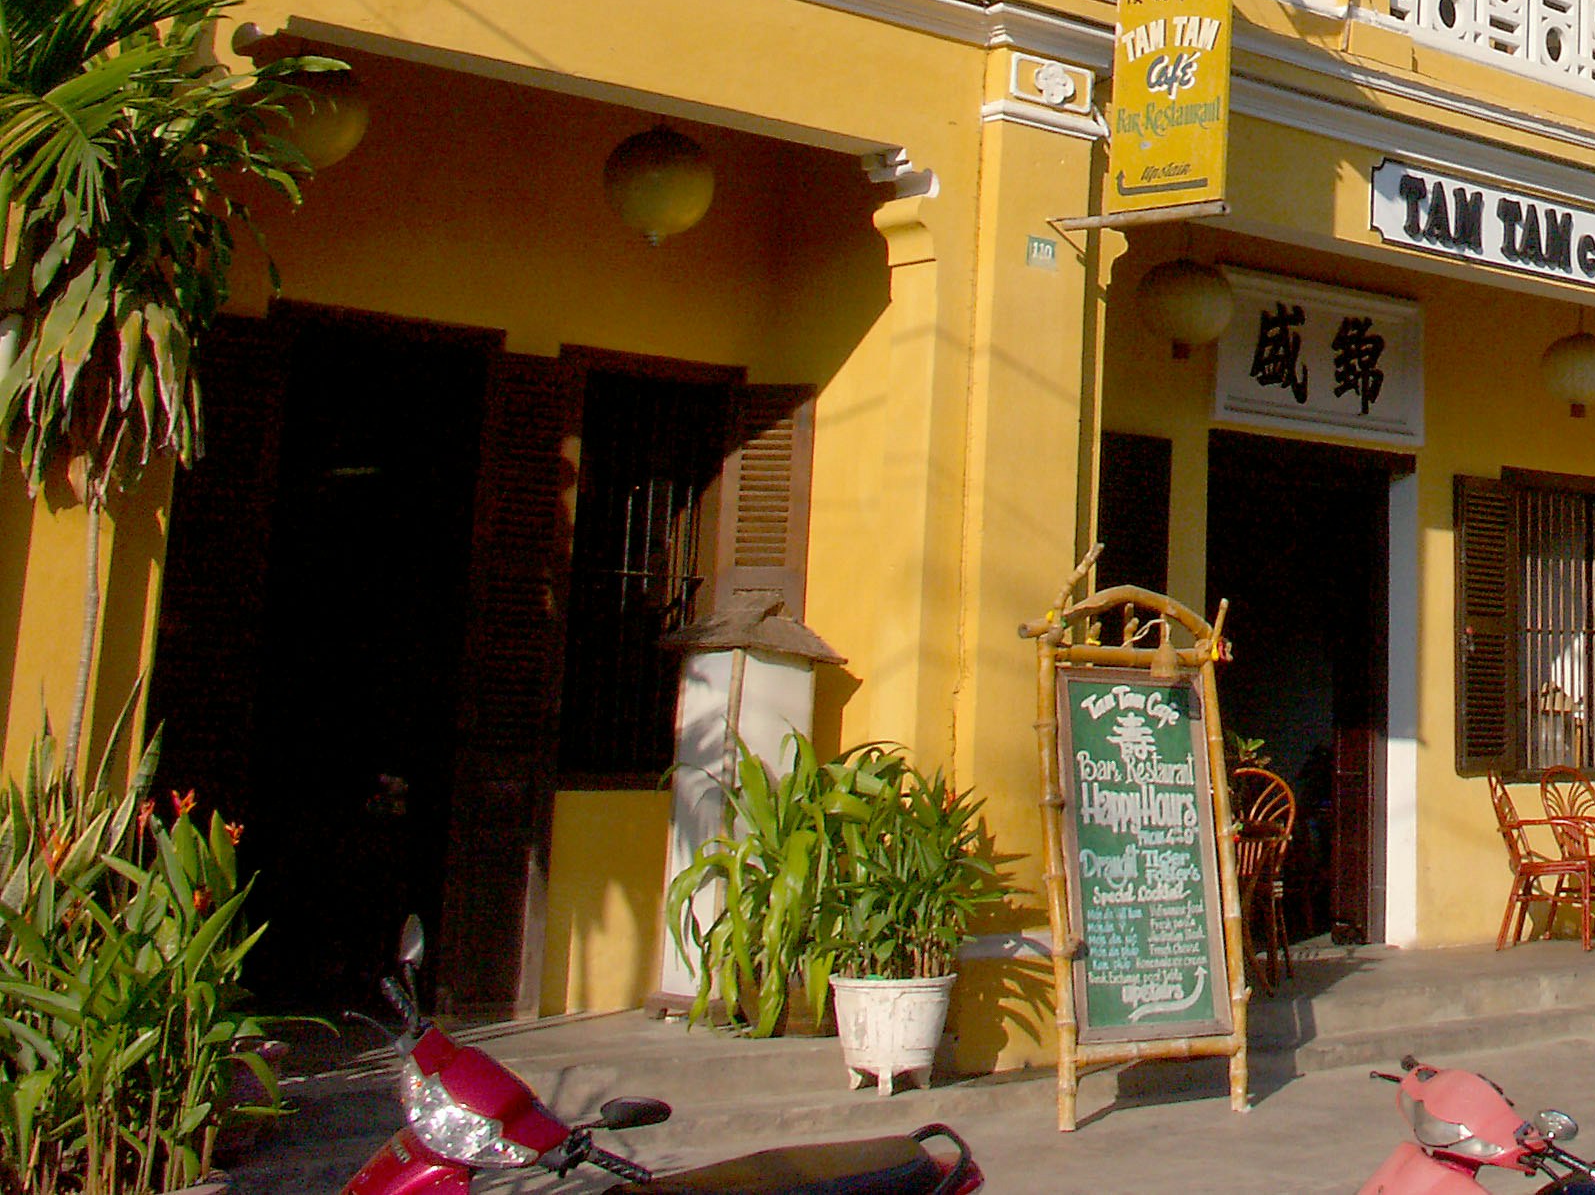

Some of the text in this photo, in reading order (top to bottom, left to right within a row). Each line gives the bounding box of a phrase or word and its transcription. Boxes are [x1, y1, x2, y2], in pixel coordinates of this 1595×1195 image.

[1121, 15, 1221, 63] TAM TAM
[1146, 52, 1201, 100] Café
[1399, 173, 1484, 255] TAM
[1496, 197, 1574, 275] TAM
[1080, 693, 1117, 720] Tam
[1111, 684, 1147, 711] Tam
[1080, 781, 1198, 835] Happy Hours
